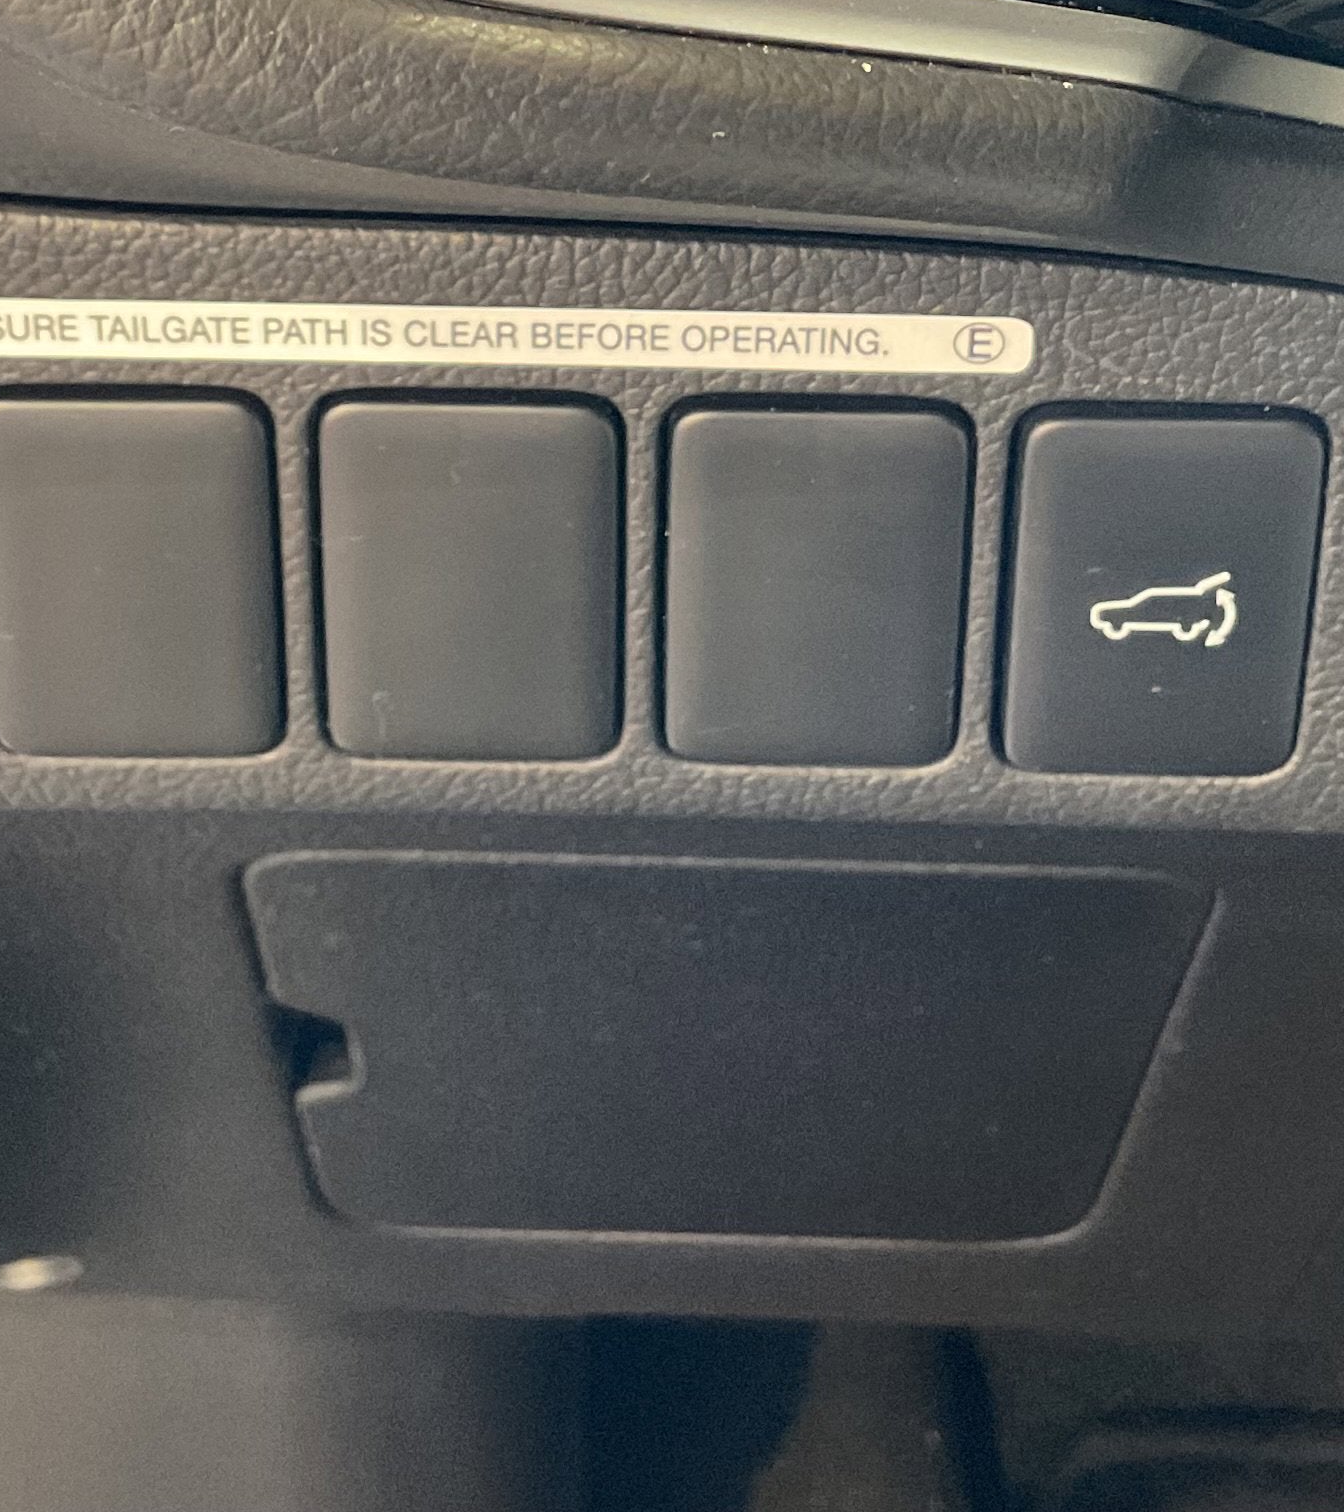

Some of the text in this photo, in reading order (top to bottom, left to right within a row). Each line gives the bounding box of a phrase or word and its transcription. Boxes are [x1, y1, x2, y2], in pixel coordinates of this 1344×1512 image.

[88, 314, 252, 346] TAILGATE
[262, 317, 349, 347] PATH
[360, 318, 393, 348] IS
[403, 319, 518, 351] CLEAR
[530, 322, 670, 352] BEFORE
[680, 324, 891, 357] OPERATING.
[962, 325, 997, 360] E
